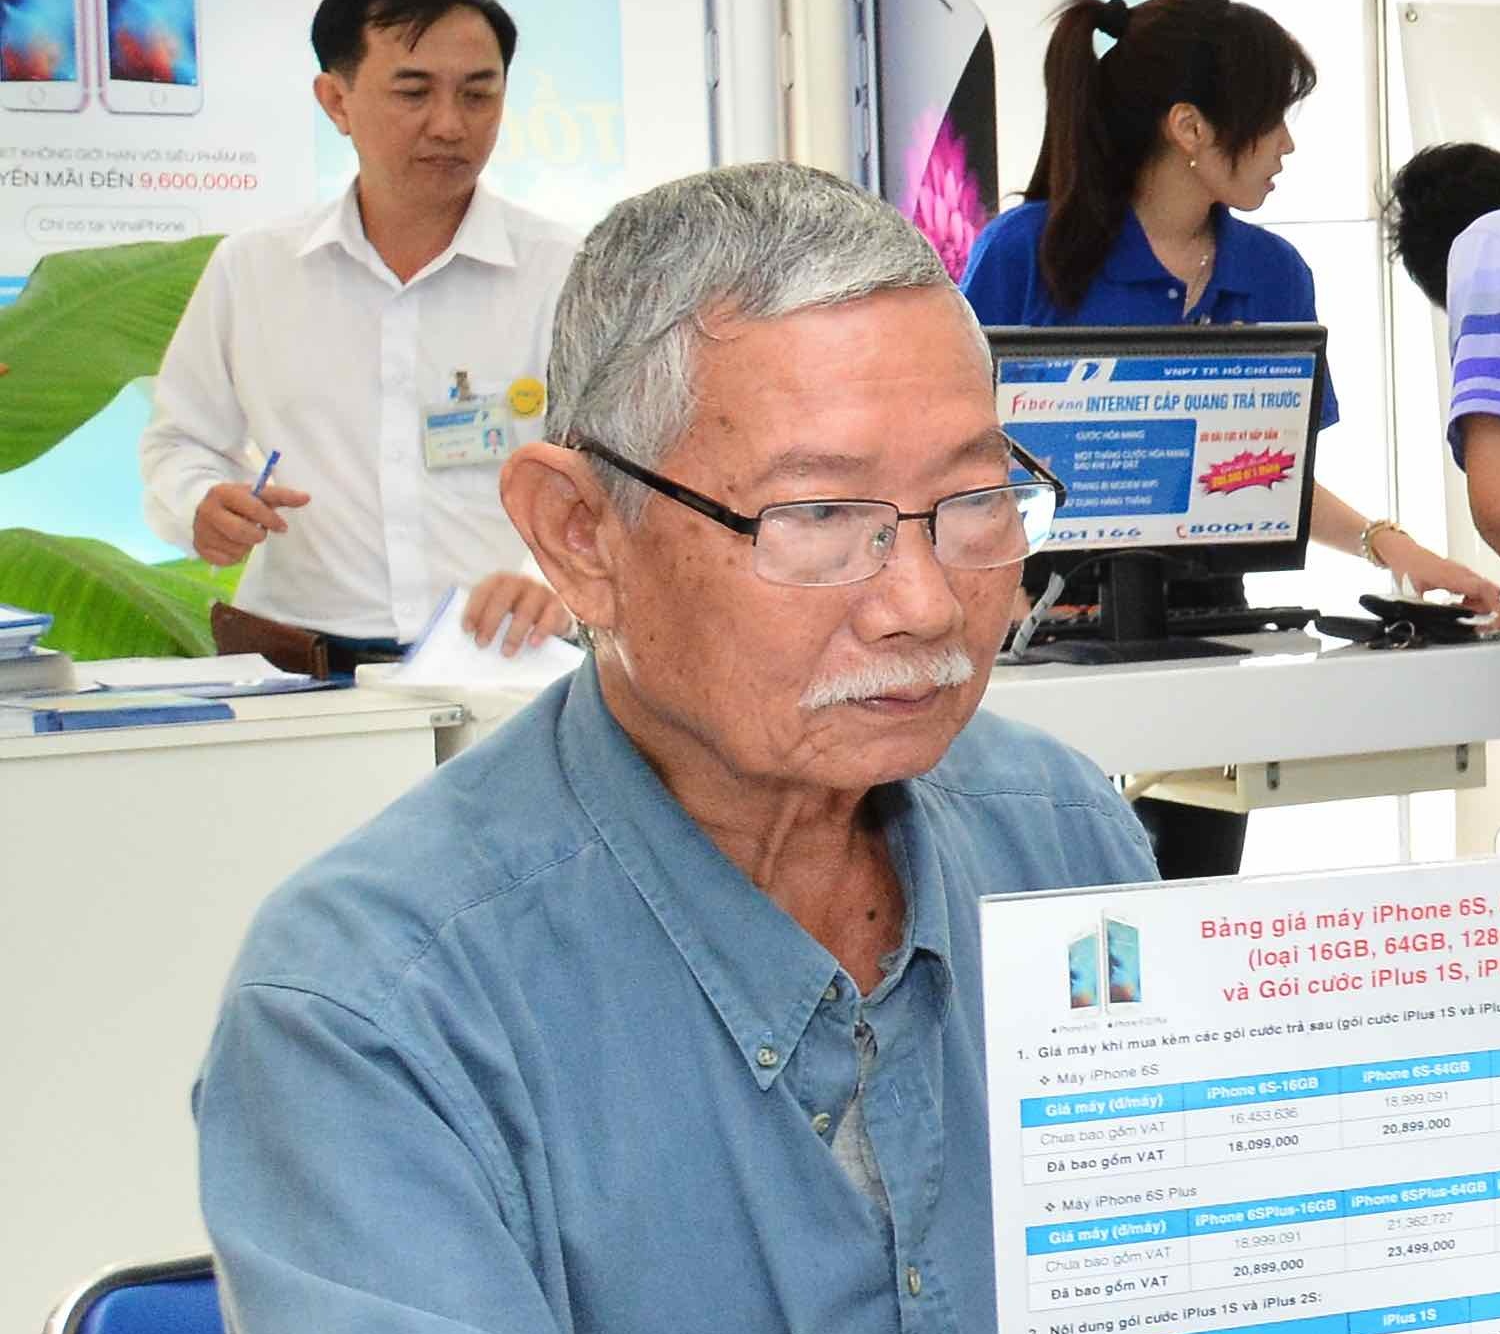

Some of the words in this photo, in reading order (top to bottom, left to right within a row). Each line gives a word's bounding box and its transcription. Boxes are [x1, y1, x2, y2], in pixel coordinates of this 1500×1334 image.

[45, 167, 83, 188] MÃI
[90, 167, 134, 188] ĐẾN
[1163, 367, 1196, 377] VNPT
[1222, 363, 1239, 375] HỒ
[1086, 395, 1150, 412] INTERNET
[1154, 392, 1180, 411] CÁP
[1184, 393, 1227, 411] QUANG
[1233, 390, 1255, 410] TRẢ
[1260, 389, 1301, 409] TRƯỚC
[1189, 520, 1291, 536] 800126
[1200, 915, 1263, 940] Bảng
[1270, 910, 1307, 938] giá
[1315, 906, 1364, 931] máy
[1371, 902, 1452, 924] iPhone
[1457, 895, 1494, 917] 6S,
[1247, 944, 1299, 972] (loại
[1306, 938, 1377, 962] 16GB,
[1383, 931, 1453, 955] 64GB,
[1222, 981, 1249, 1002] và
[1257, 976, 1299, 999] Gói
[1306, 971, 1363, 995] cước
[1370, 967, 1428, 988] iPlus
[1434, 961, 1470, 982] 1S,
[1016, 1048, 1030, 1060] 1.
[1036, 1045, 1062, 1059] Giá
[1066, 1043, 1097, 1056] máy
[1100, 1039, 1123, 1052] khi
[1126, 1037, 1157, 1050] mua
[1160, 1033, 1190, 1046] kèm
[1193, 1031, 1219, 1043] các
[1222, 1026, 1246, 1043] gói
[1248, 1023, 1283, 1038] cước
[1284, 1018, 1305, 1034] trả
[1306, 1020, 1334, 1035] sau
[1335, 1014, 1364, 1032] (gói
[1365, 1011, 1400, 1026] cước
[1401, 1009, 1436, 1022] iPlus
[1438, 1005, 1457, 1019] 1S
[1458, 1002, 1476, 1017] và
[1055, 1071, 1086, 1086] Máy
[1089, 1066, 1137, 1081] iPhone
[1139, 1062, 1160, 1077] 6S
[1361, 1068, 1410, 1084] iPhone
[1410, 1058, 1471, 1078] 6S-64GB
[1205, 1084, 1256, 1100] iPhone
[1257, 1075, 1318, 1095] 6S-16GB
[1381, 1116, 1451, 1135] 20,899,000
[1227, 1133, 1300, 1153] 18,099,000
[1045, 1159, 1066, 1173] Đã
[1069, 1158, 1097, 1171] bao
[1099, 1152, 1132, 1171] gồm
[1135, 1148, 1165, 1163] VAT
[1077, 1319, 1115, 1334] dung
[1117, 1313, 1141, 1331] gói
[1143, 1309, 1179, 1325] cước
[1181, 1306, 1217, 1320] iPlus
[1220, 1301, 1238, 1315] 1S
[1240, 1298, 1259, 1312] và
[1262, 1295, 1297, 1309] iPlus
[1299, 1290, 1322, 1305] 2S:
